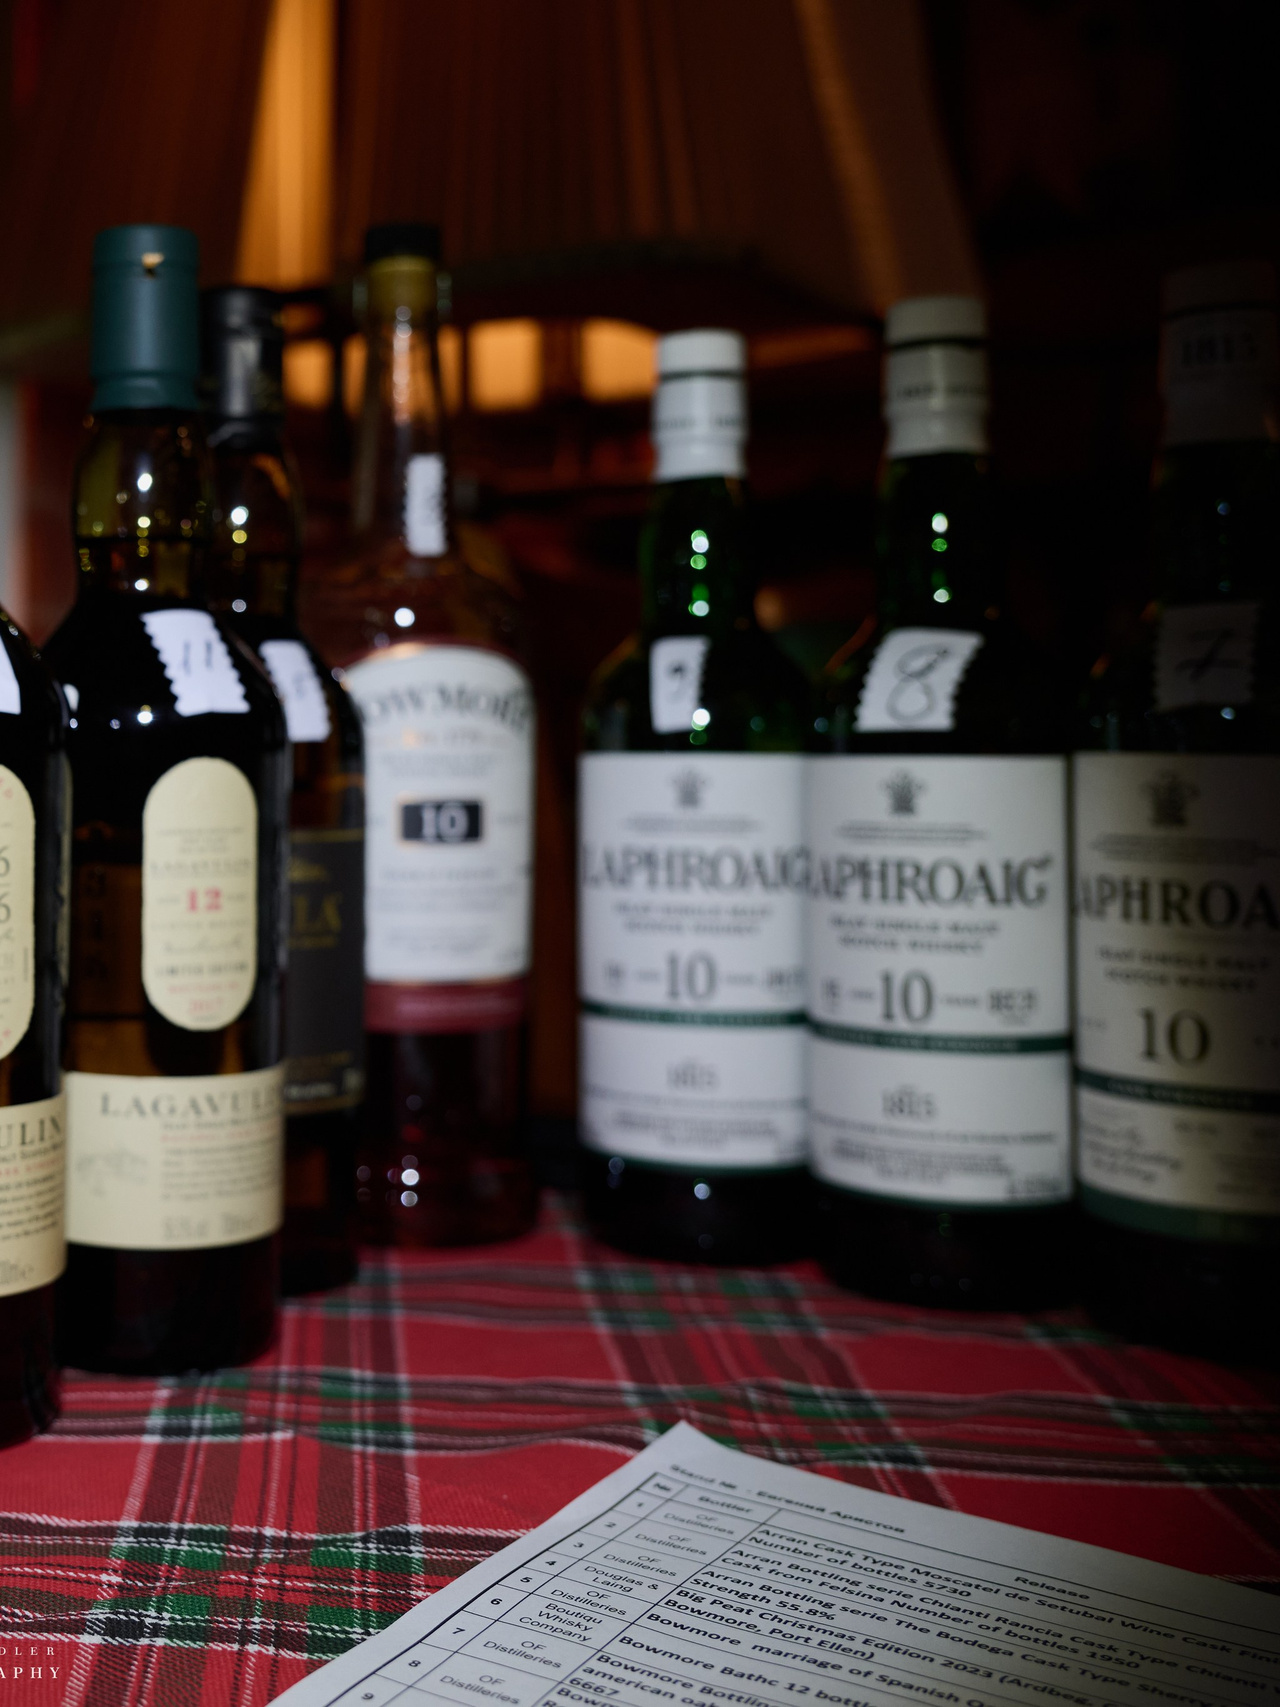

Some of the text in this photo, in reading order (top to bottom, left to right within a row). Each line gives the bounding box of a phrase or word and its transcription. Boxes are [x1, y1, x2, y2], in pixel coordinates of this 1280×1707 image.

[885, 641, 952, 729] 8
[362, 682, 534, 738] OWMORE
[421, 802, 470, 842] 10
[186, 887, 223, 914] 12
[810, 855, 1052, 910] APHROAIG
[666, 949, 718, 1003] 10
[879, 967, 936, 1026] 10
[1138, 1005, 1210, 1069] 10
[584, 1565, 645, 1588] Douglas
[586, 1590, 612, 1601] OF
[591, 1576, 634, 1594] Laing
[813, 1542, 1176, 1640] Cask Type Moscatel Setubal Wine
[922, 1580, 972, 1598] 5730
[1014, 1576, 1091, 1600] Release
[490, 1598, 603, 1625] 6 Boutiqu
[550, 1589, 628, 1616] Distilleries
[689, 1578, 836, 1621] Strength 55.8%
[731, 1549, 1120, 1654] Arran Bottling serie Chianti Rancia Cask
[519, 1616, 593, 1643] Company
[538, 1610, 594, 1632] Whisky
[663, 1598, 876, 1661] Bowmore, Port Ellen)
[676, 1589, 994, 1679] Big Peat Christmas Edition 2023
[700, 1570, 1071, 1672] Arran Bottling The Bodega Cask
[818, 1581, 1140, 1669] Felsina Number 1950
[408, 1660, 422, 1669] 8
[483, 1640, 563, 1669] Distilleries
[520, 1640, 548, 1651] OF
[646, 1613, 961, 1703] Bowmore marriage of Spanish
[581, 1666, 677, 1700] american
[596, 1654, 694, 1690] Bowmore
[618, 1635, 812, 1695] Bowmore Bathc 12
[568, 1677, 621, 1697] 6667
